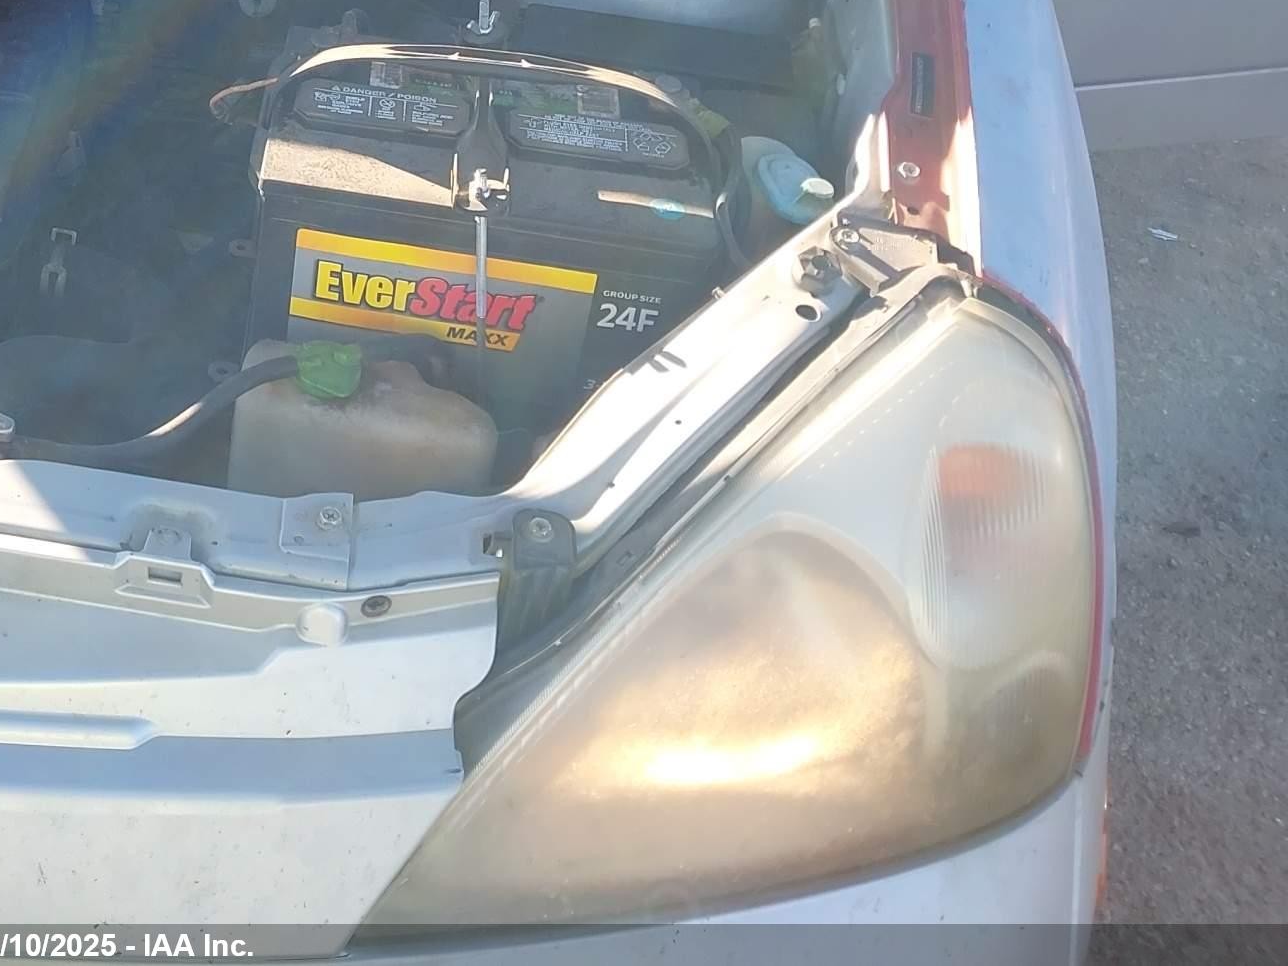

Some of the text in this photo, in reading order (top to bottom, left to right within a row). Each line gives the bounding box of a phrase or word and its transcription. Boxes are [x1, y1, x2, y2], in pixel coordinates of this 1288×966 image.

[342, 86, 387, 98] DANGER
[397, 92, 437, 104] POISON
[314, 259, 538, 330] EverStart
[603, 290, 662, 304] GROUP SIZE
[596, 303, 659, 332] 24F
[446, 326, 510, 347] MAXX
